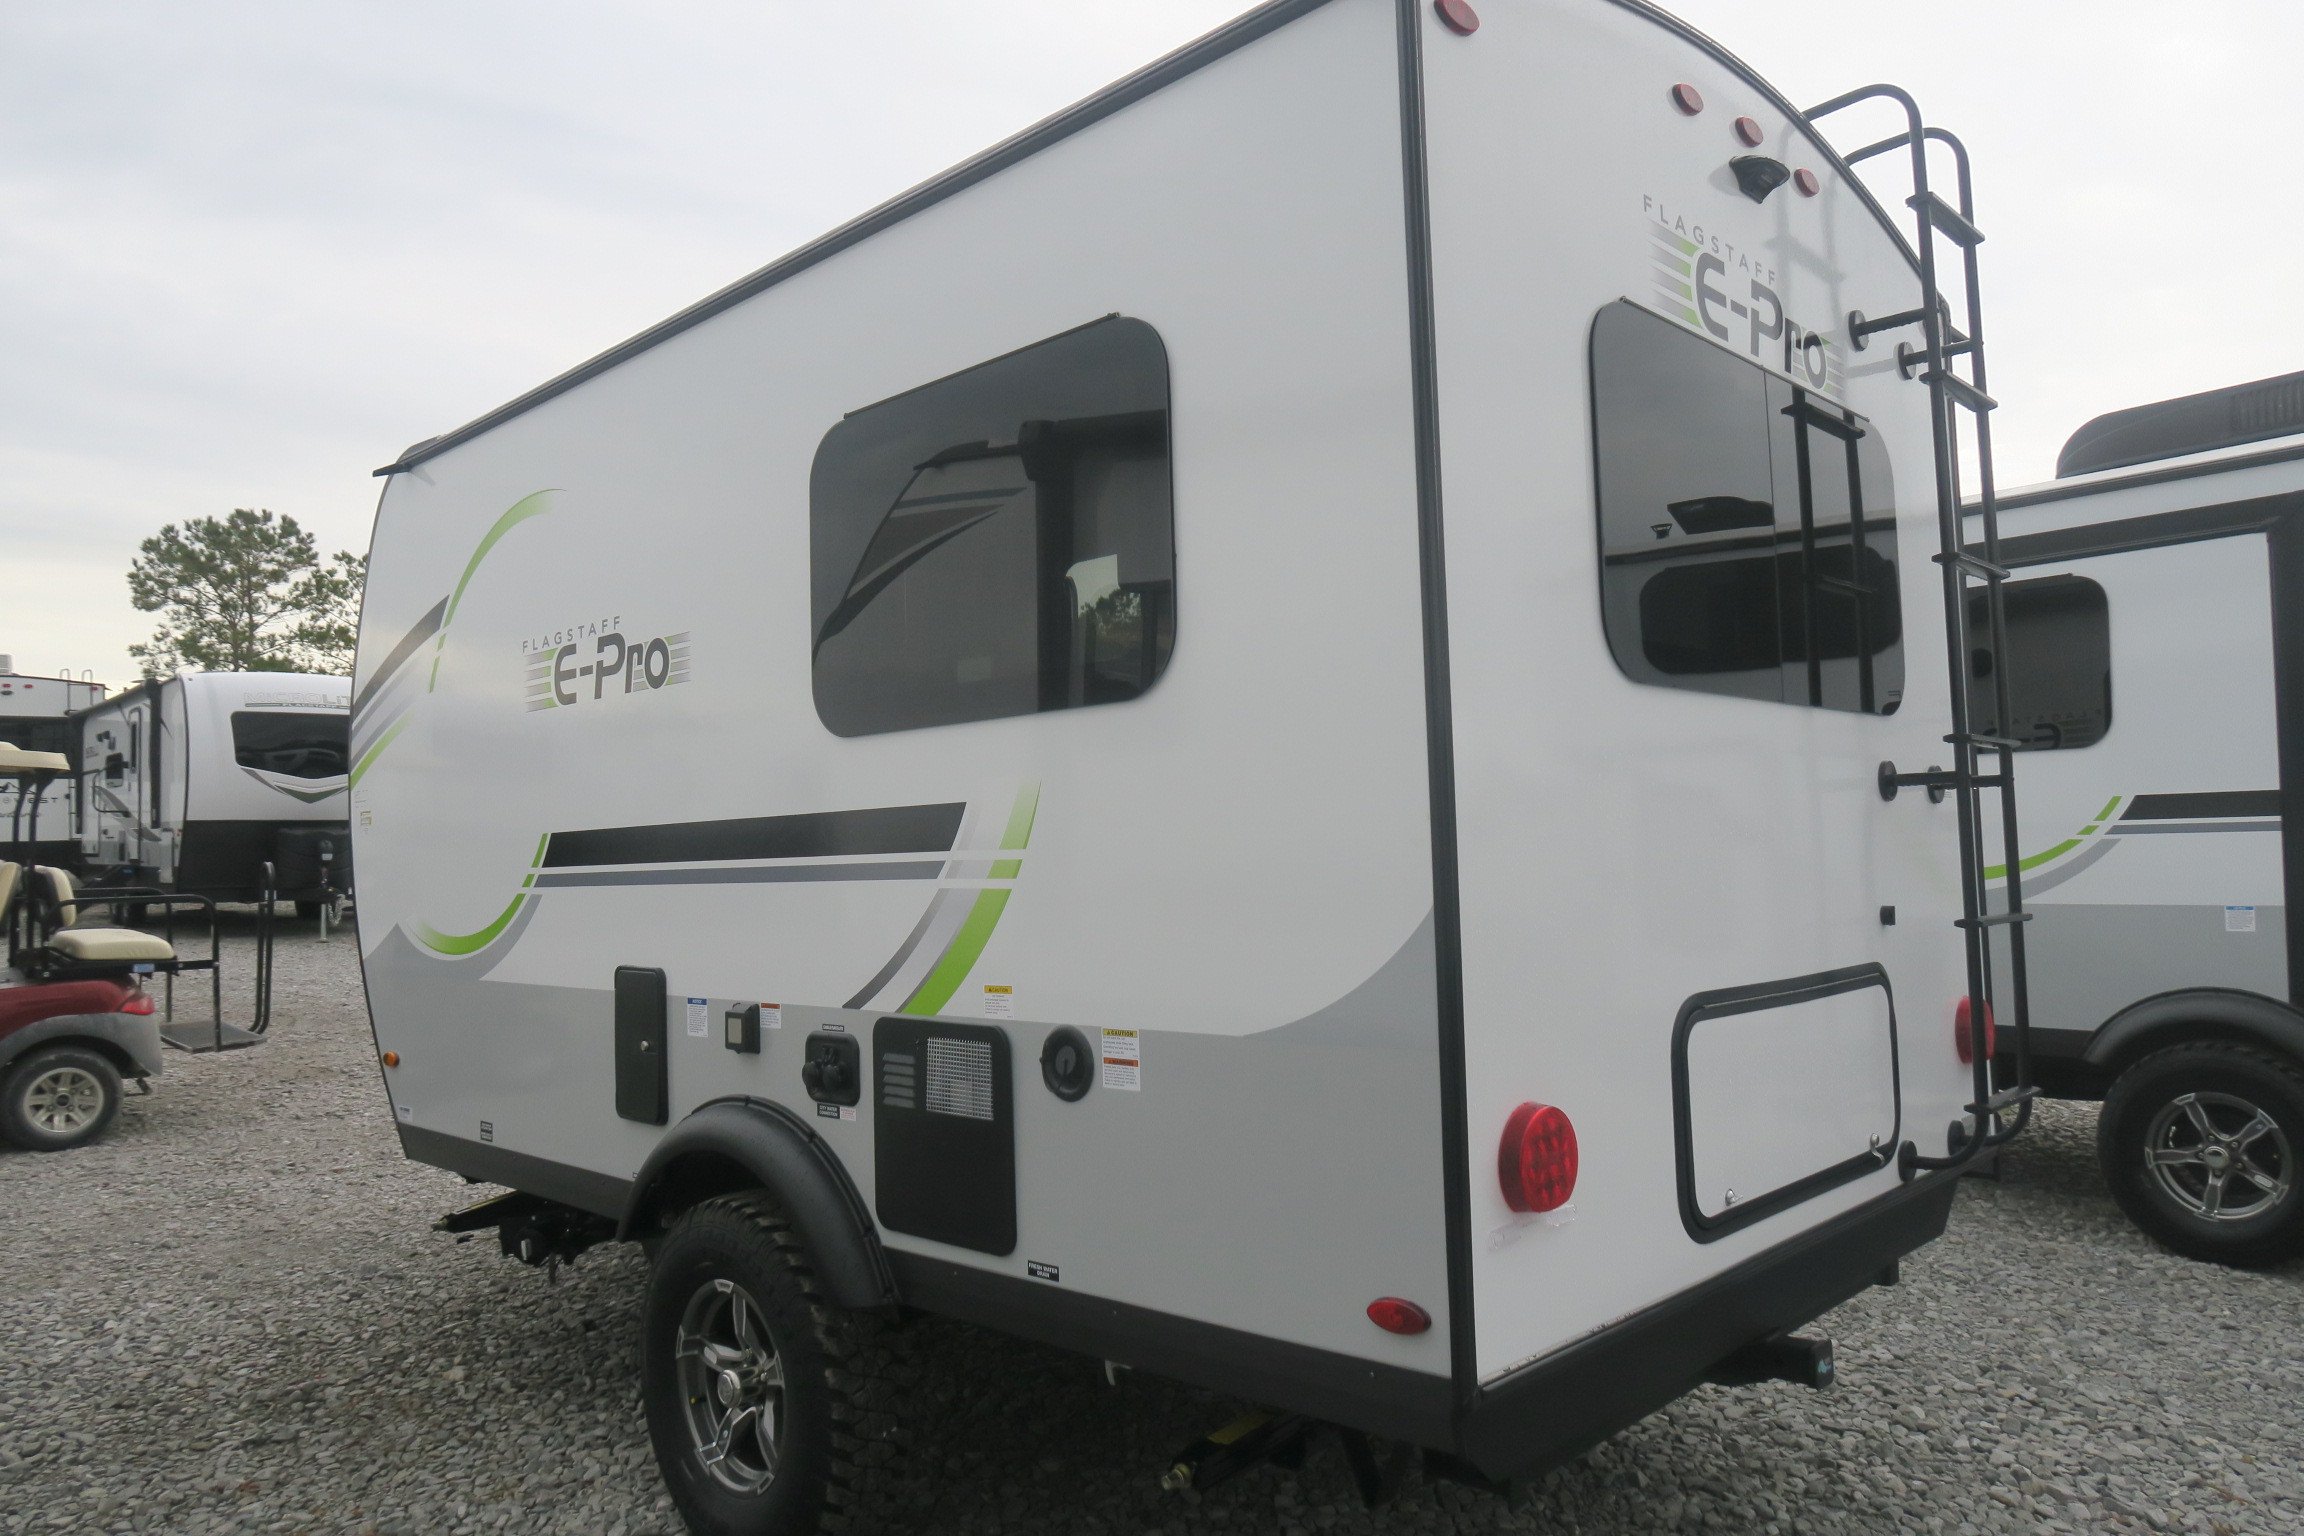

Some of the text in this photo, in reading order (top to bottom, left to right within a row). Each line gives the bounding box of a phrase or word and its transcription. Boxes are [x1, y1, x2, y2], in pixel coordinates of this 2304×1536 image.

[1643, 193, 1776, 286] FLAGSTAFF
[1695, 252, 1827, 390] E-Pro
[522, 615, 621, 653] FLAGSTAFF
[554, 632, 670, 706] E-Pro
[1110, 1029, 1134, 1037] CAUTION
